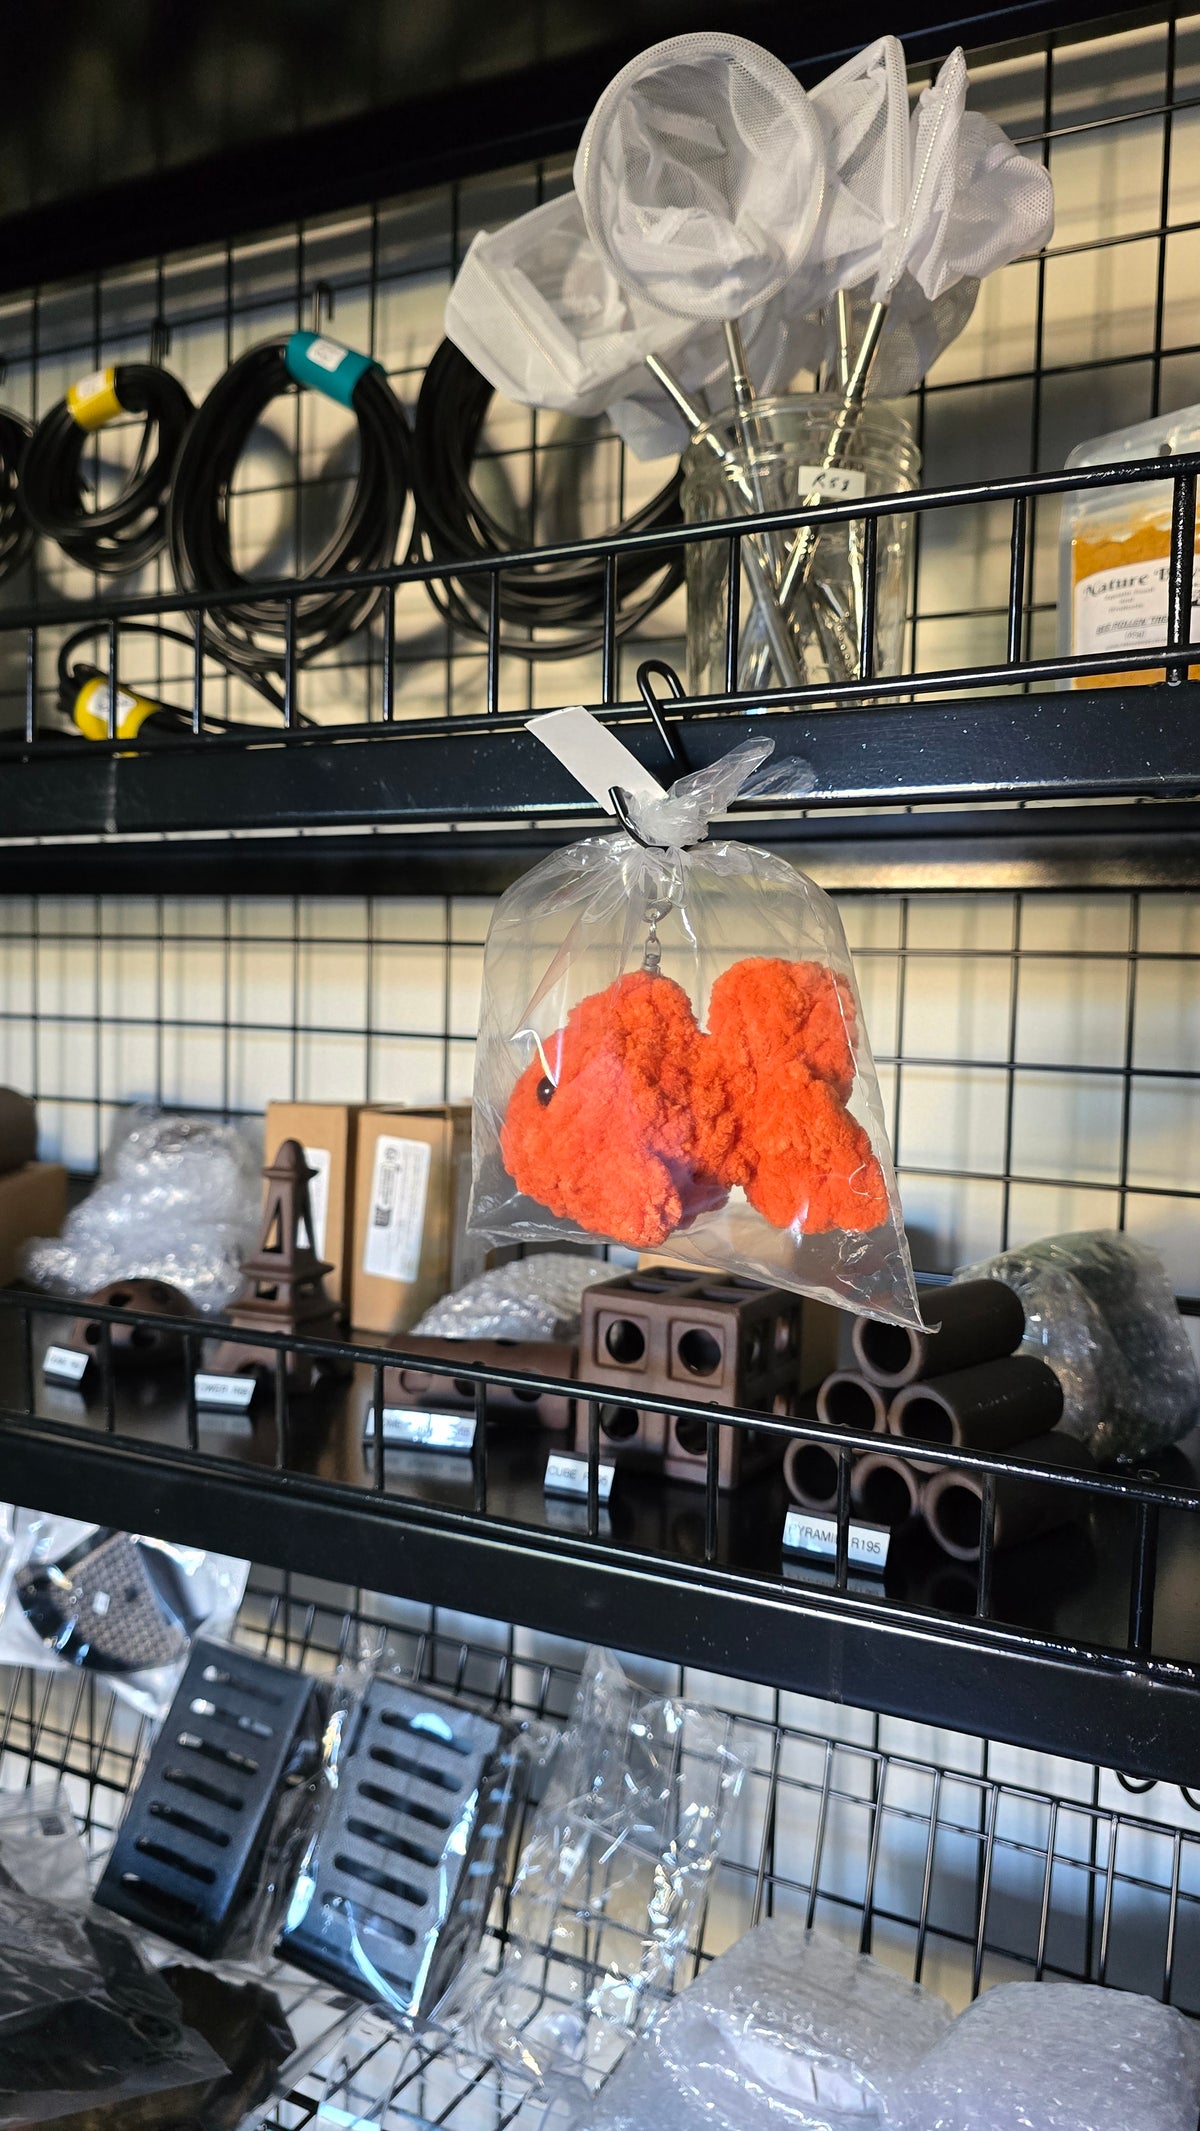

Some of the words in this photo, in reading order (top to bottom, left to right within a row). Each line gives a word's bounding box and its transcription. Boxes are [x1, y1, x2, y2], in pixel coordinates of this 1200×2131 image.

[1082, 573, 1149, 598] Nature
[788, 1523, 838, 1545] PYRAMI
[851, 1537, 881, 1554] R195
